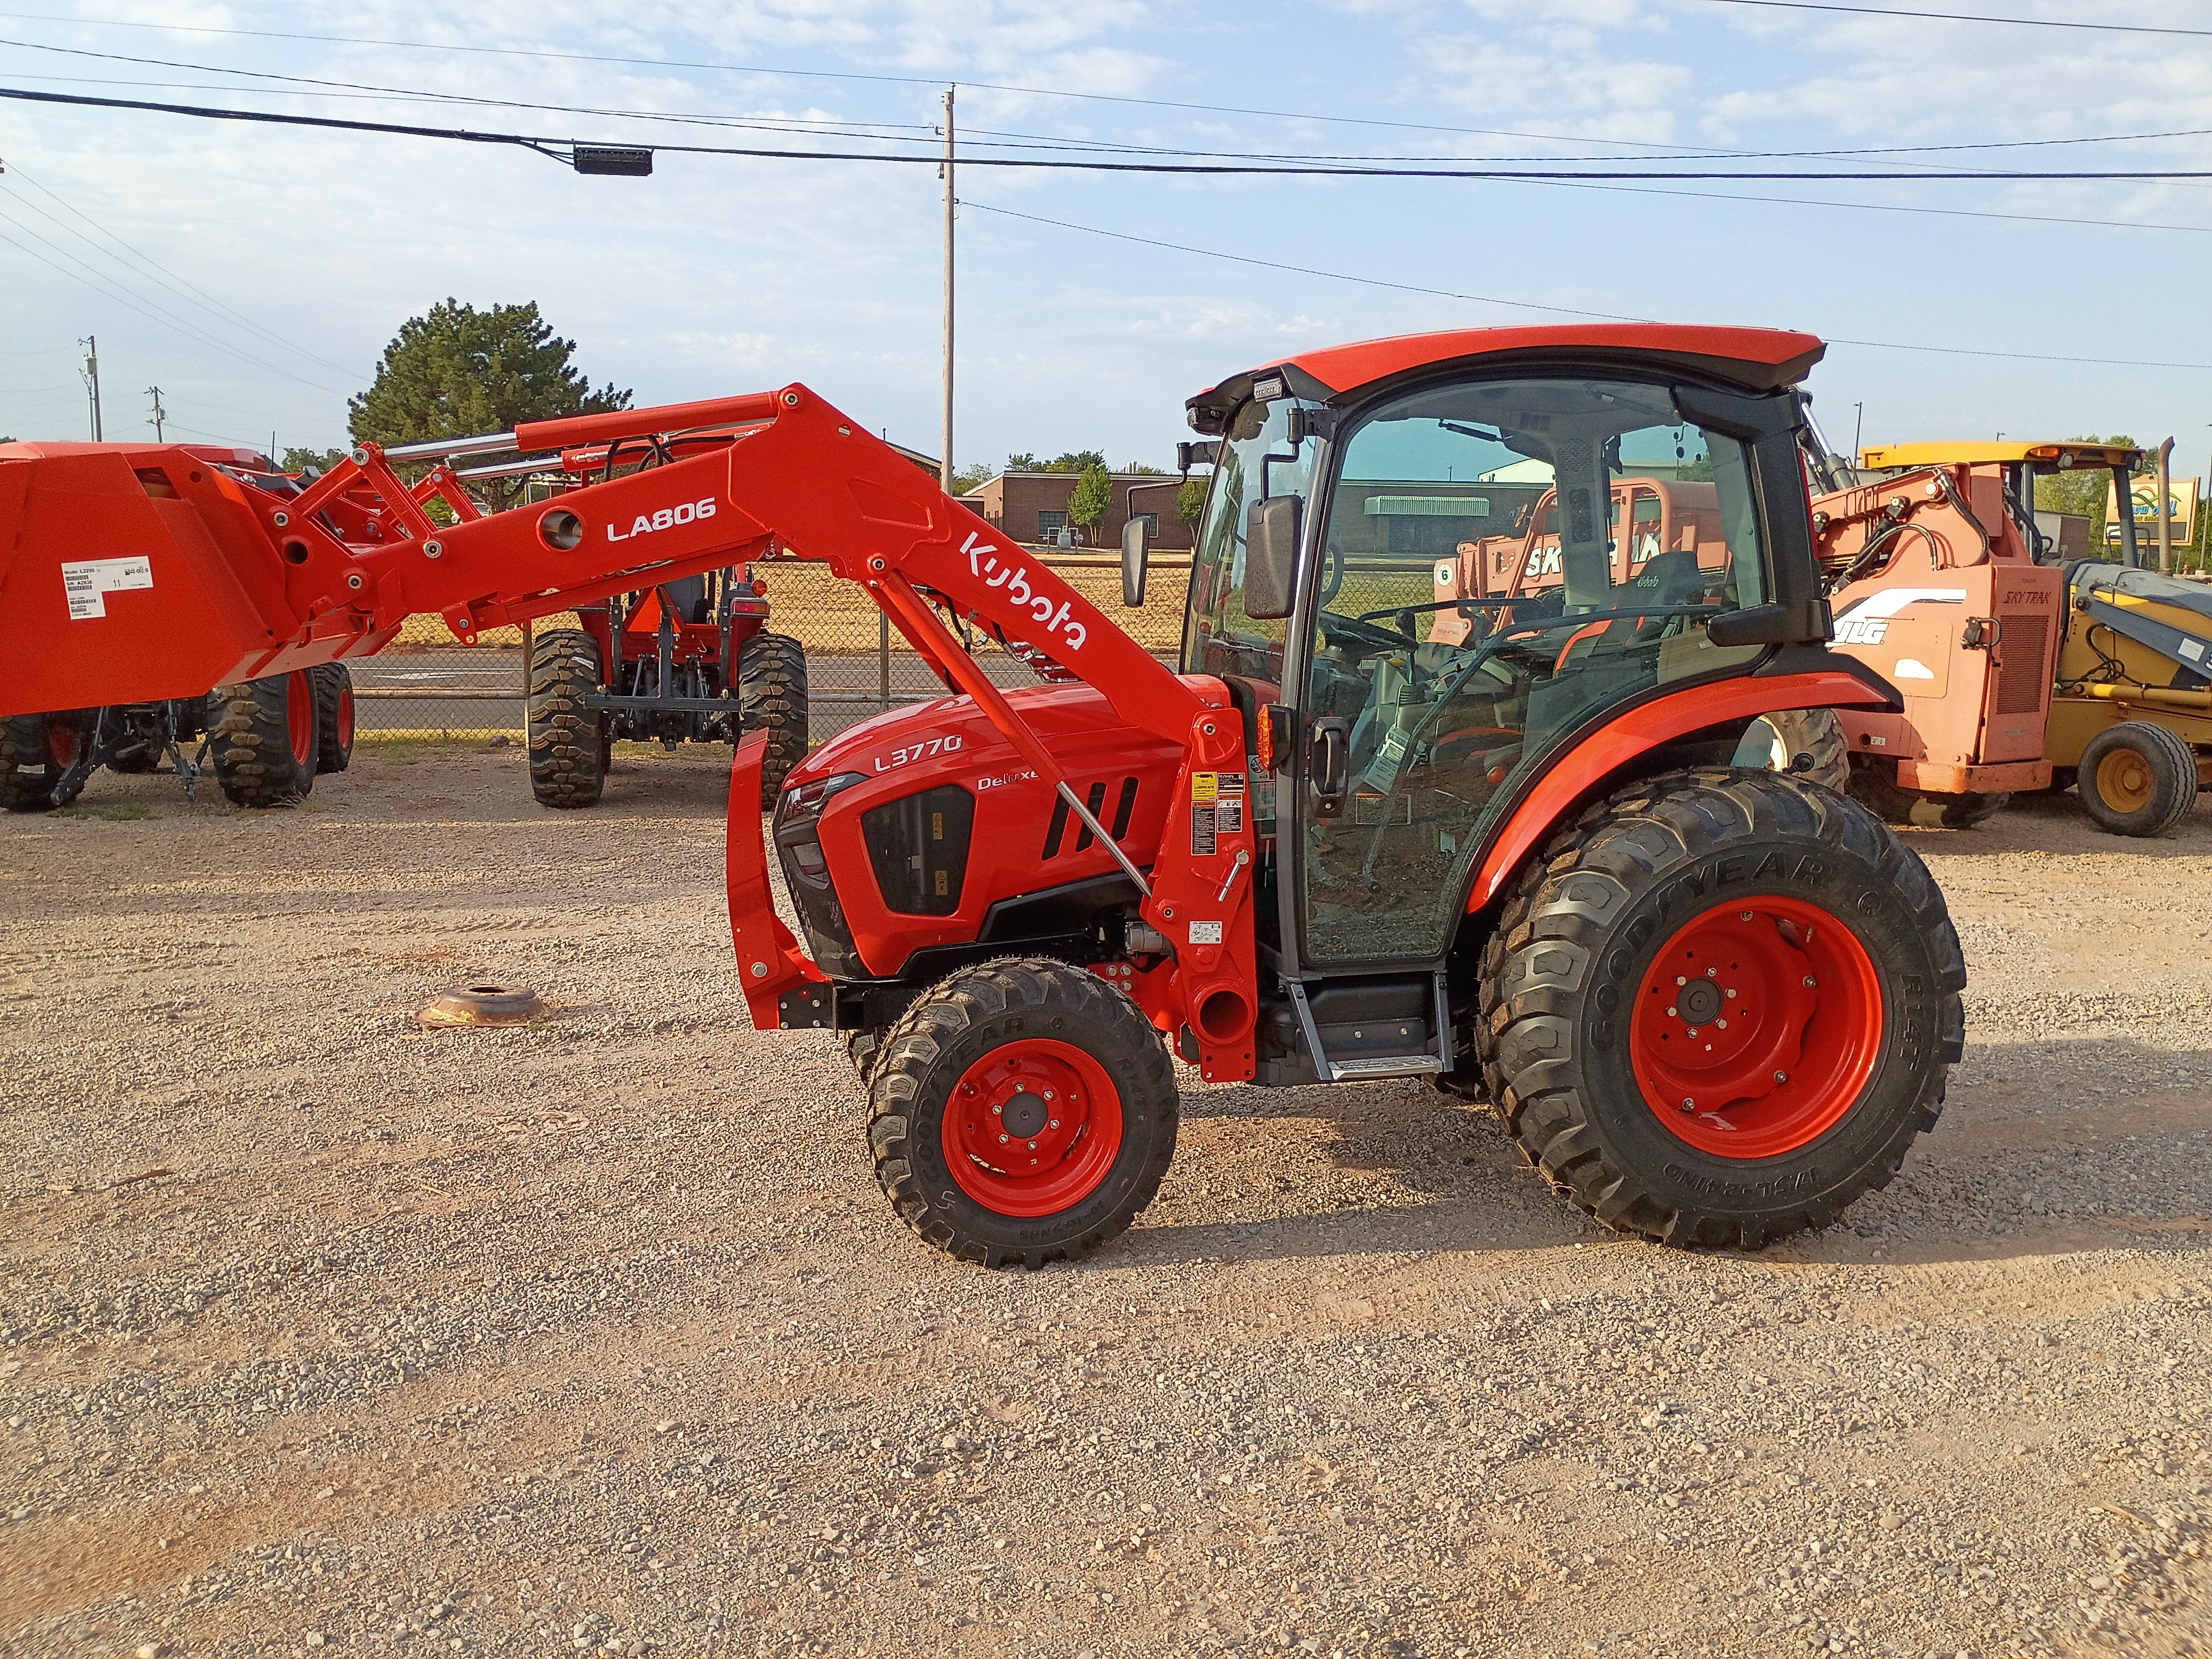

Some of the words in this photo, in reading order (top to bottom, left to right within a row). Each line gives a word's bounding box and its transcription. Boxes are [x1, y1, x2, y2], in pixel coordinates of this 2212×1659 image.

[607, 497, 716, 542] LA806
[959, 531, 1087, 651] Kubota
[1441, 570, 1448, 580] 6
[1833, 621, 1890, 645] JLG
[874, 734, 962, 772] L3770
[978, 771, 1038, 790] Deluxe
[1589, 851, 1834, 1052] GOODYEAR
